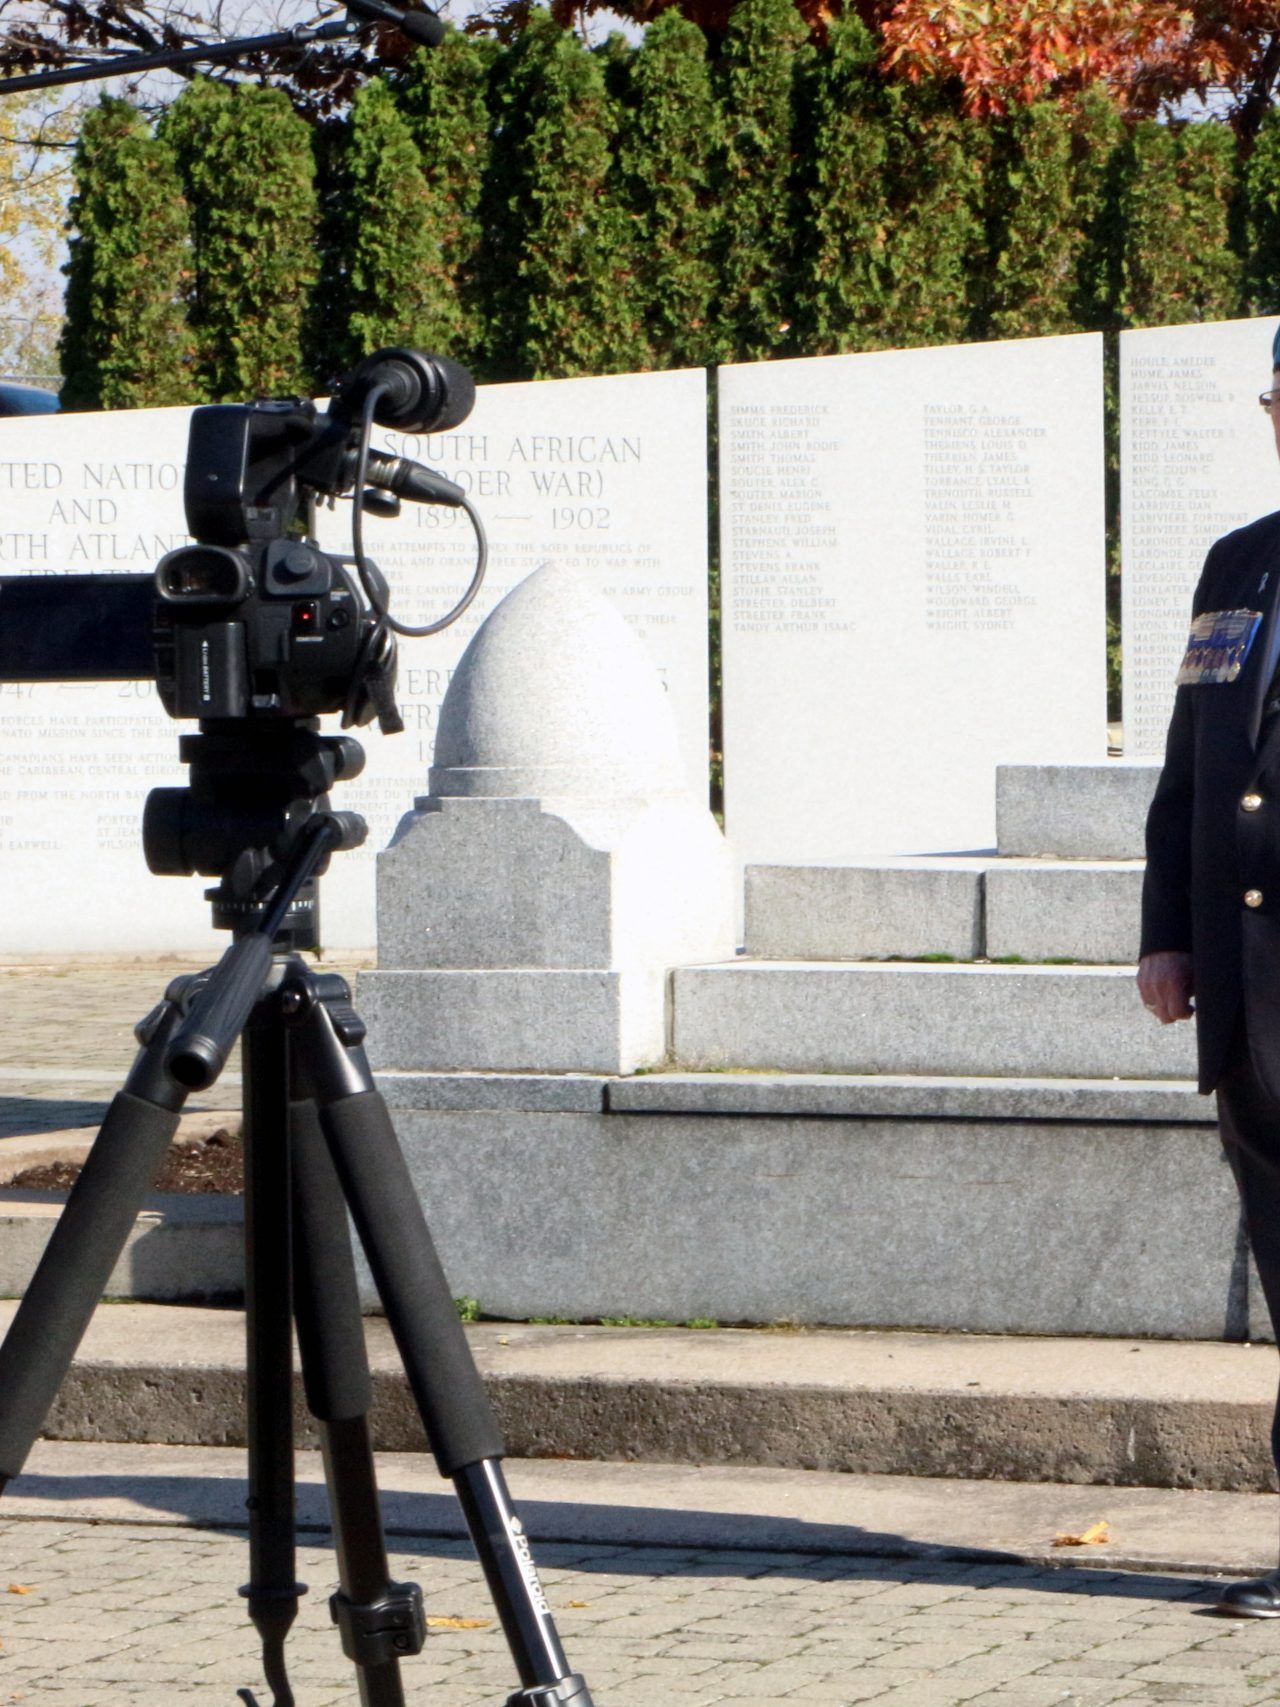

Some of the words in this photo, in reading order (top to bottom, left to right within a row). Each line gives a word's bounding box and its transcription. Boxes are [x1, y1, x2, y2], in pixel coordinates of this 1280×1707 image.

[384, 433, 488, 462] SOUTH
[508, 435, 642, 463] AFRICAN
[84, 464, 186, 491] NATIO
[49, 499, 118, 525] AND
[552, 507, 610, 530] 1902
[514, 1534, 551, 1615] Polaroid
